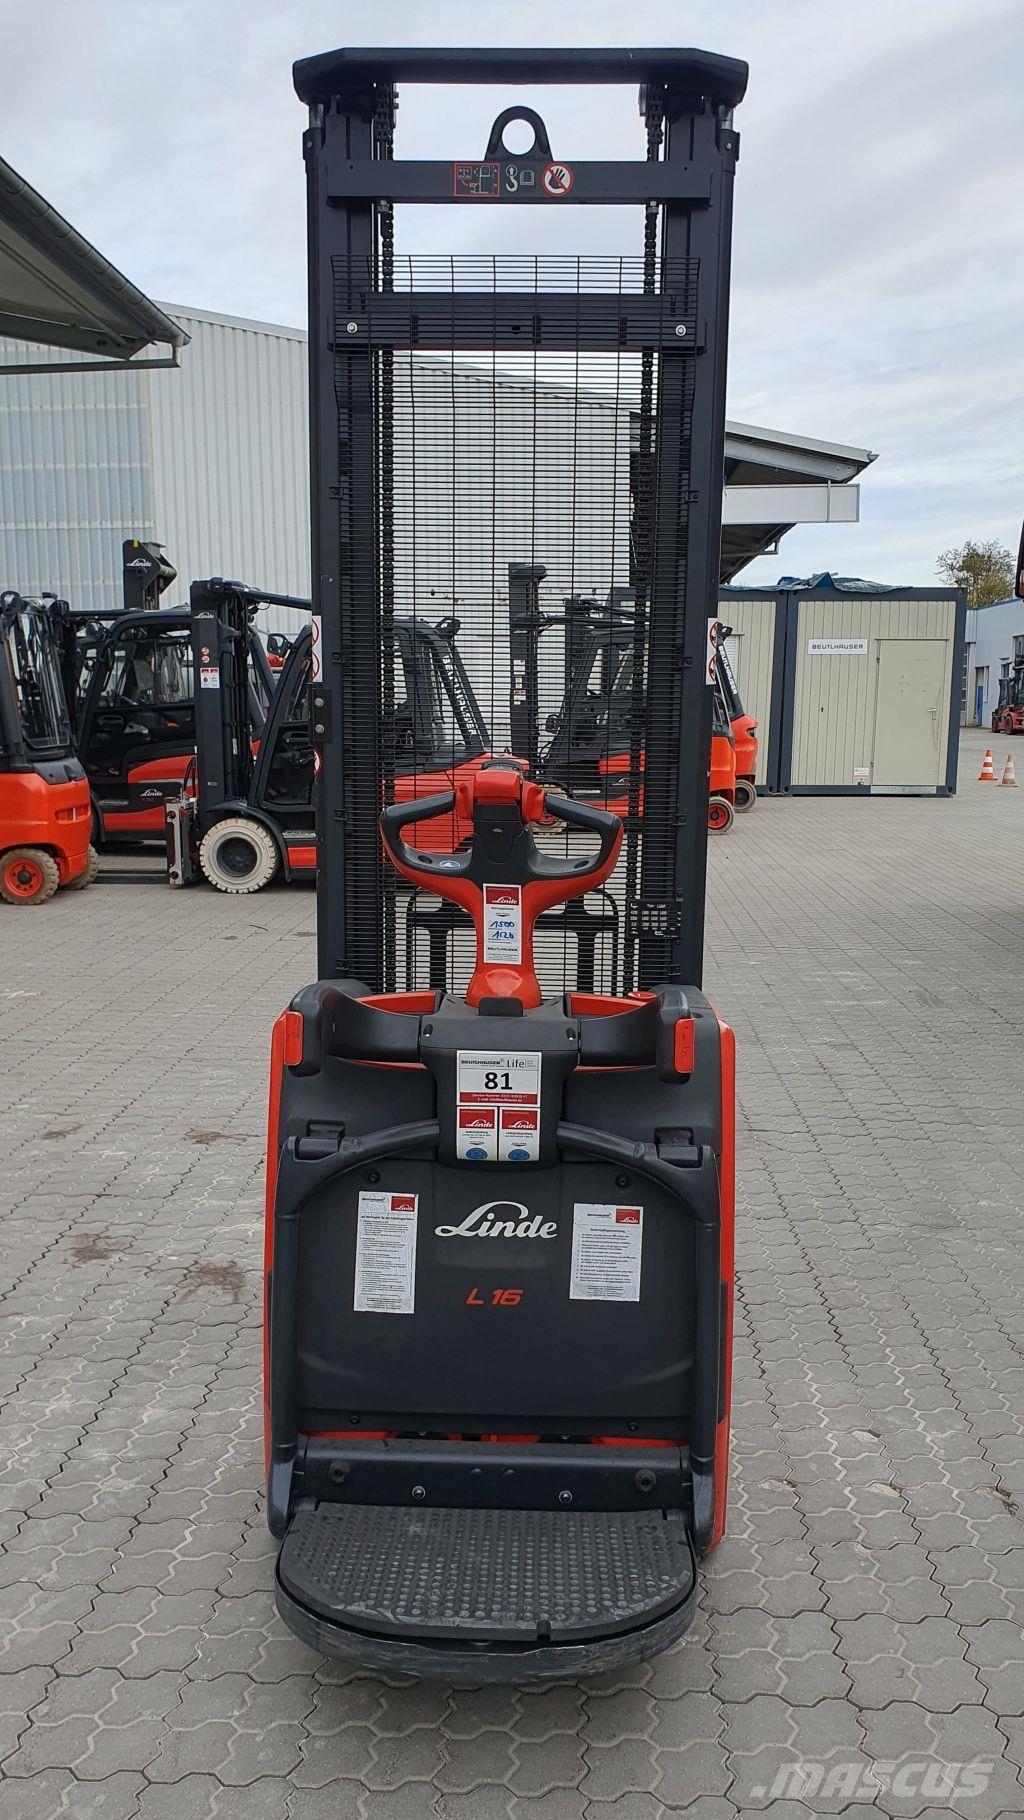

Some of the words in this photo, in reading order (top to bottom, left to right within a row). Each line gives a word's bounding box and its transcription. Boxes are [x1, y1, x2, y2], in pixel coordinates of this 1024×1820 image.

[126, 558, 152, 567] Linde
[193, 611, 215, 619] Linde
[718, 645, 738, 695] BEUTLHAUSER
[139, 788, 163, 797] Linde
[491, 895, 518, 905] Linde
[507, 1058, 525, 1068] Life
[484, 1071, 513, 1090] 81
[465, 1118, 494, 1128] Linde
[508, 1120, 536, 1129] Linde
[435, 1201, 557, 1239] Linde
[466, 1288, 484, 1304] L
[492, 1289, 524, 1306] 16
